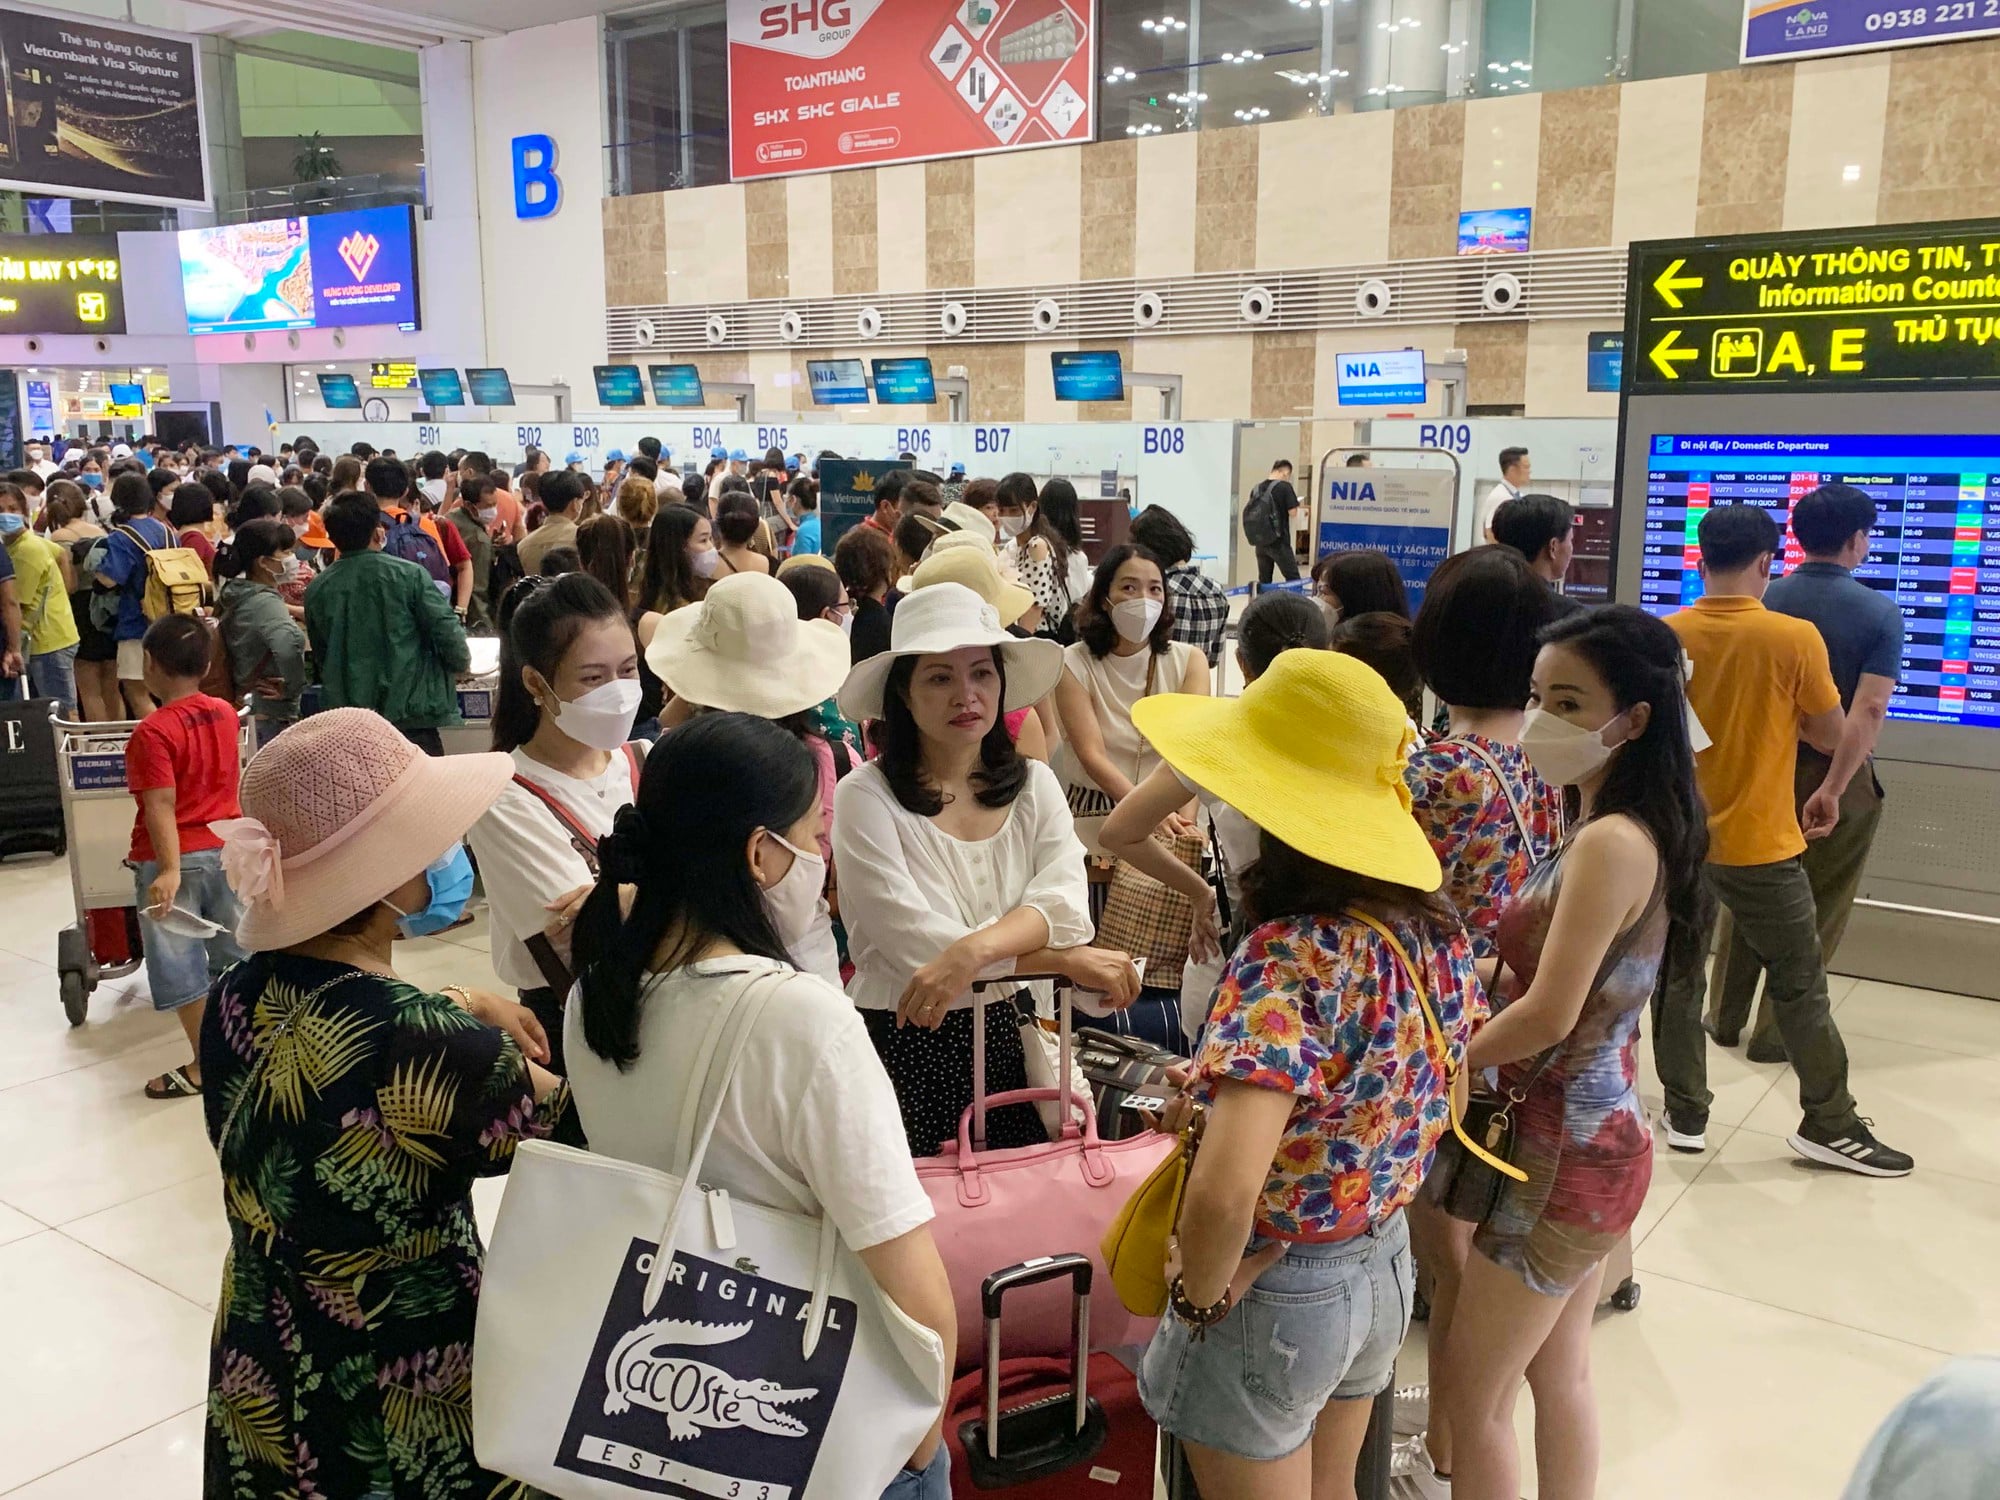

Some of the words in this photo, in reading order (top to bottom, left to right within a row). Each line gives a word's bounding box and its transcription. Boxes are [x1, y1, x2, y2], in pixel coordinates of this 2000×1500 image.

[760, 0, 851, 40] SHG
[1865, 8, 1927, 32] 0938
[1934, 1, 1976, 23] 221
[1983, 0, 2000, 18] 2
[819, 29, 851, 43] GROUP
[1785, 24, 1828, 38] LAND
[23, 42, 99, 66] Vietcombank
[101, 56, 126, 70] Visa
[128, 61, 180, 79] Signature
[104, 40, 131, 57] dụng
[135, 45, 163, 60] Quốc
[166, 51, 178, 63] tế
[784, 66, 866, 92] TOANTHANG
[753, 108, 790, 126] SHX
[797, 102, 835, 120] SHC
[841, 92, 901, 113] GIALE
[511, 133, 563, 220] B
[1729, 252, 1806, 282] QUÀY
[1811, 246, 1910, 276] THÔNG
[1918, 246, 1972, 272] TIN,
[1981, 243, 2000, 267] T
[1758, 280, 1905, 308] Information
[1893, 313, 1948, 344] THỦ
[1829, 328, 1867, 372] E
[814, 370, 838, 383] NIA
[1346, 362, 1381, 378] NIA
[419, 426, 441, 446] B01
[517, 426, 542, 446] B02
[573, 426, 600, 449] B03
[692, 427, 722, 450] B04
[758, 427, 788, 450] B05
[897, 428, 932, 453] B06
[974, 428, 1010, 453] B07
[1144, 427, 1184, 454] B08
[1419, 424, 1471, 454] B09
[1681, 441, 1691, 450] Đi
[1692, 441, 1709, 452] nội
[1709, 441, 1724, 452] địa
[1732, 441, 1776, 451] Domestic
[1777, 441, 1829, 452] Departures
[1822, 474, 1832, 482] 12
[1331, 481, 1376, 501] NIA
[1320, 541, 1350, 552] KHUNG
[1391, 542, 1402, 554] LÝ
[1404, 543, 1429, 555] XÁCH
[1430, 546, 1447, 556] TAY
[1402, 558, 1420, 567] TEST
[636, 1253, 841, 1331] ORIGINAL
